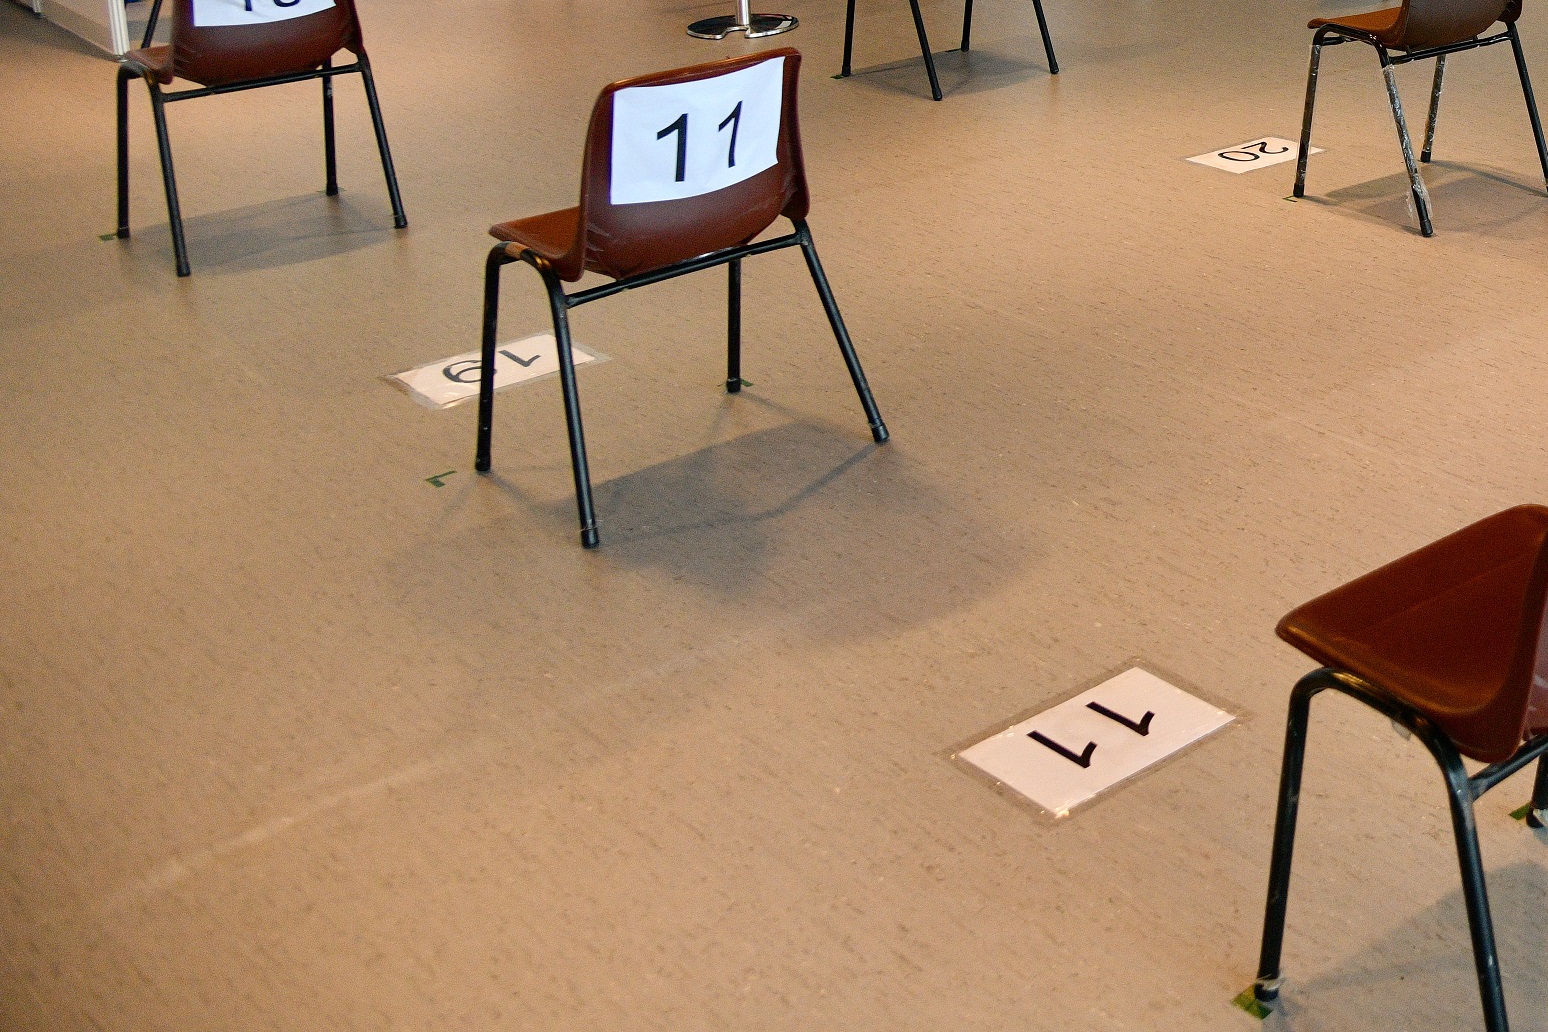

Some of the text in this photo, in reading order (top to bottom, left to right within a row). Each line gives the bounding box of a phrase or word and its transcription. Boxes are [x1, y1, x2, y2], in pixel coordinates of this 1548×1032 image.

[656, 99, 744, 183] 11
[1217, 141, 1290, 162] 20
[1026, 700, 1156, 769] 11
